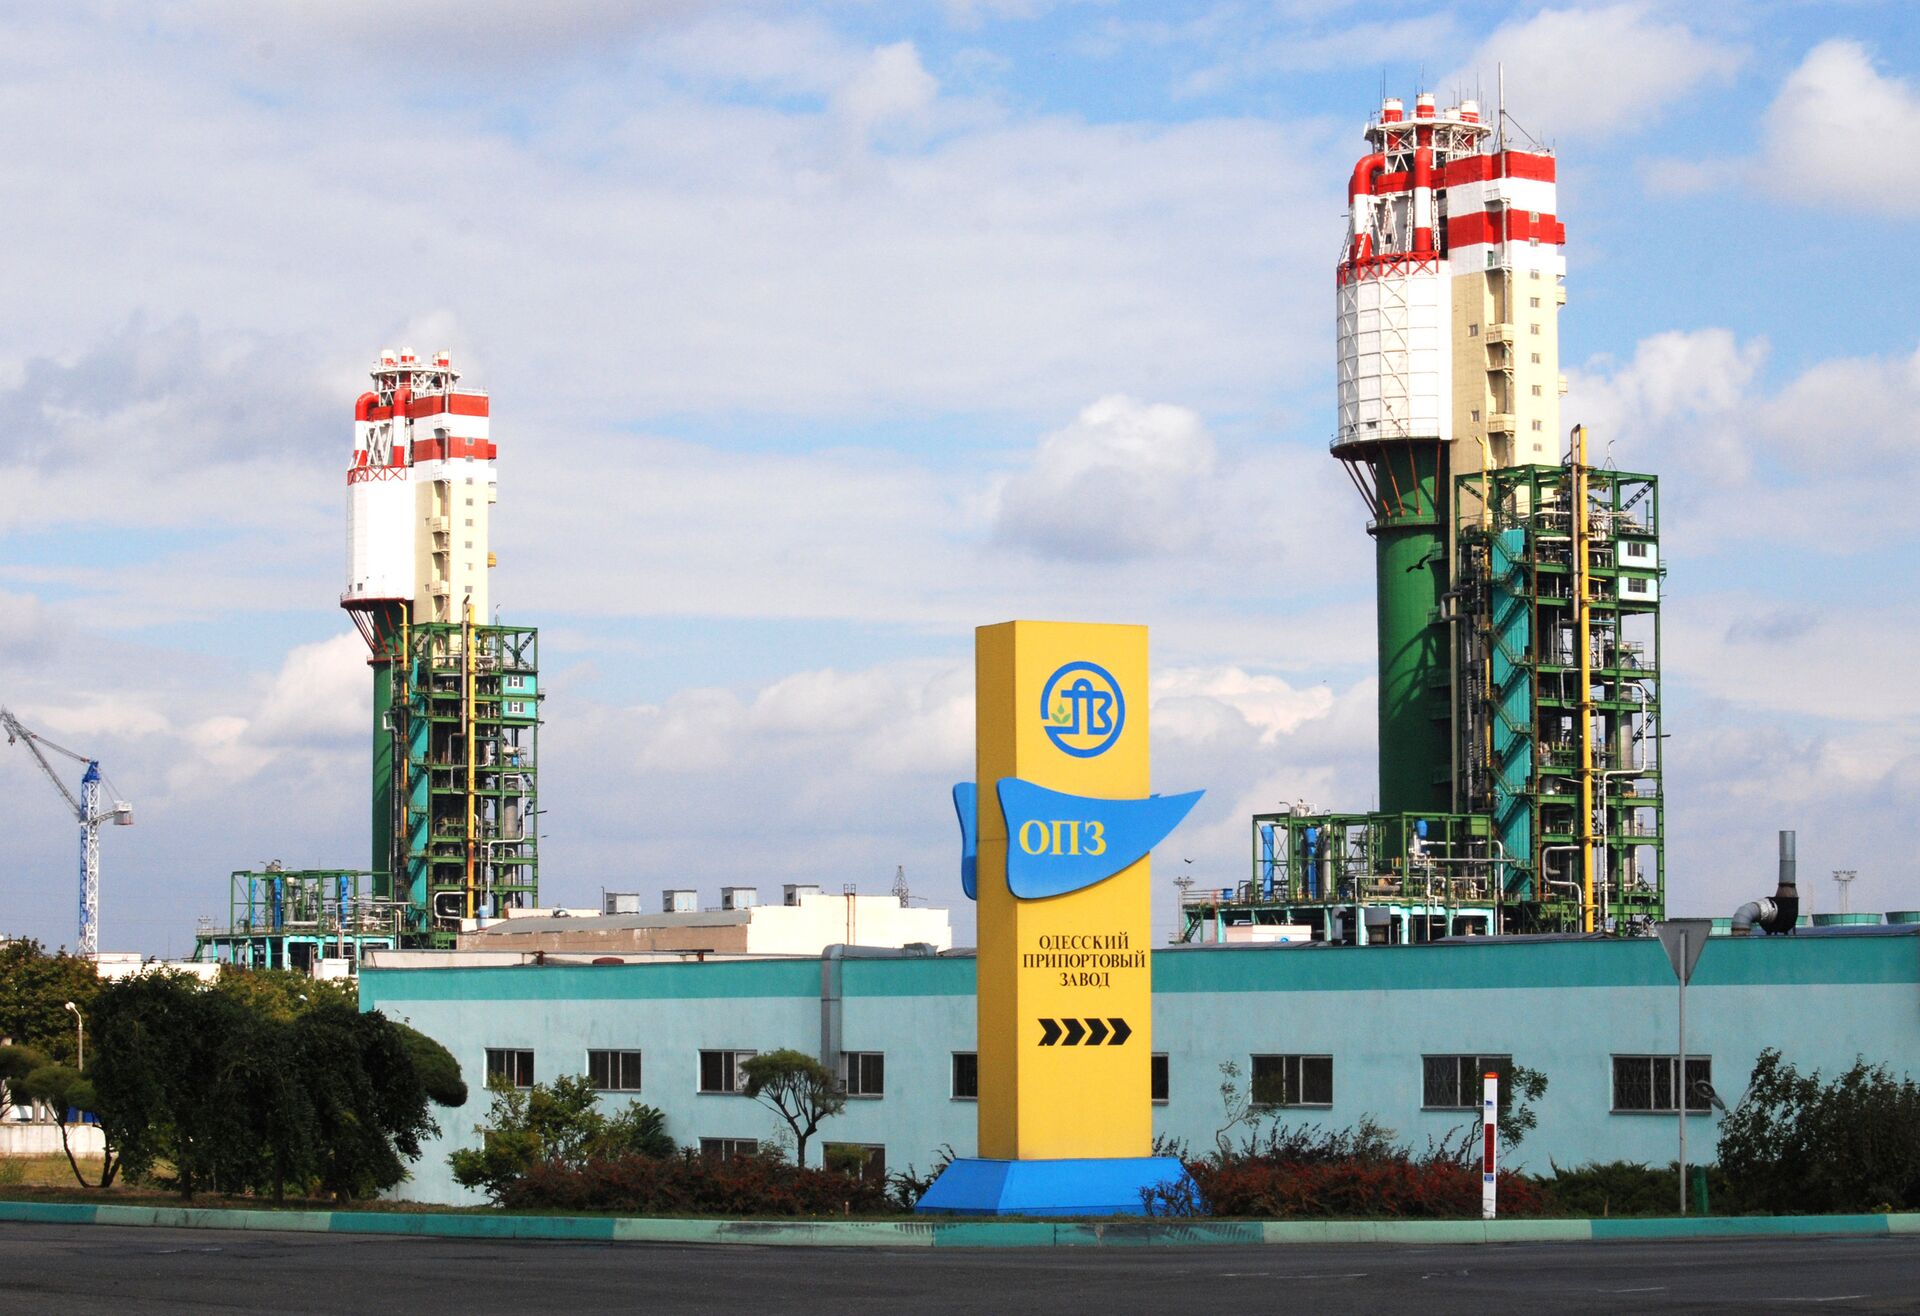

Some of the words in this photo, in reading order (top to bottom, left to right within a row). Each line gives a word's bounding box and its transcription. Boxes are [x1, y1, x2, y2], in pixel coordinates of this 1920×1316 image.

[1019, 819, 1107, 856] ОПЗ
[1038, 931, 1129, 951] ОДЕССКИЙ
[1023, 950, 1145, 968] ПРИПОРТОВЫЙ
[1059, 972, 1110, 988] ЗАВОД
